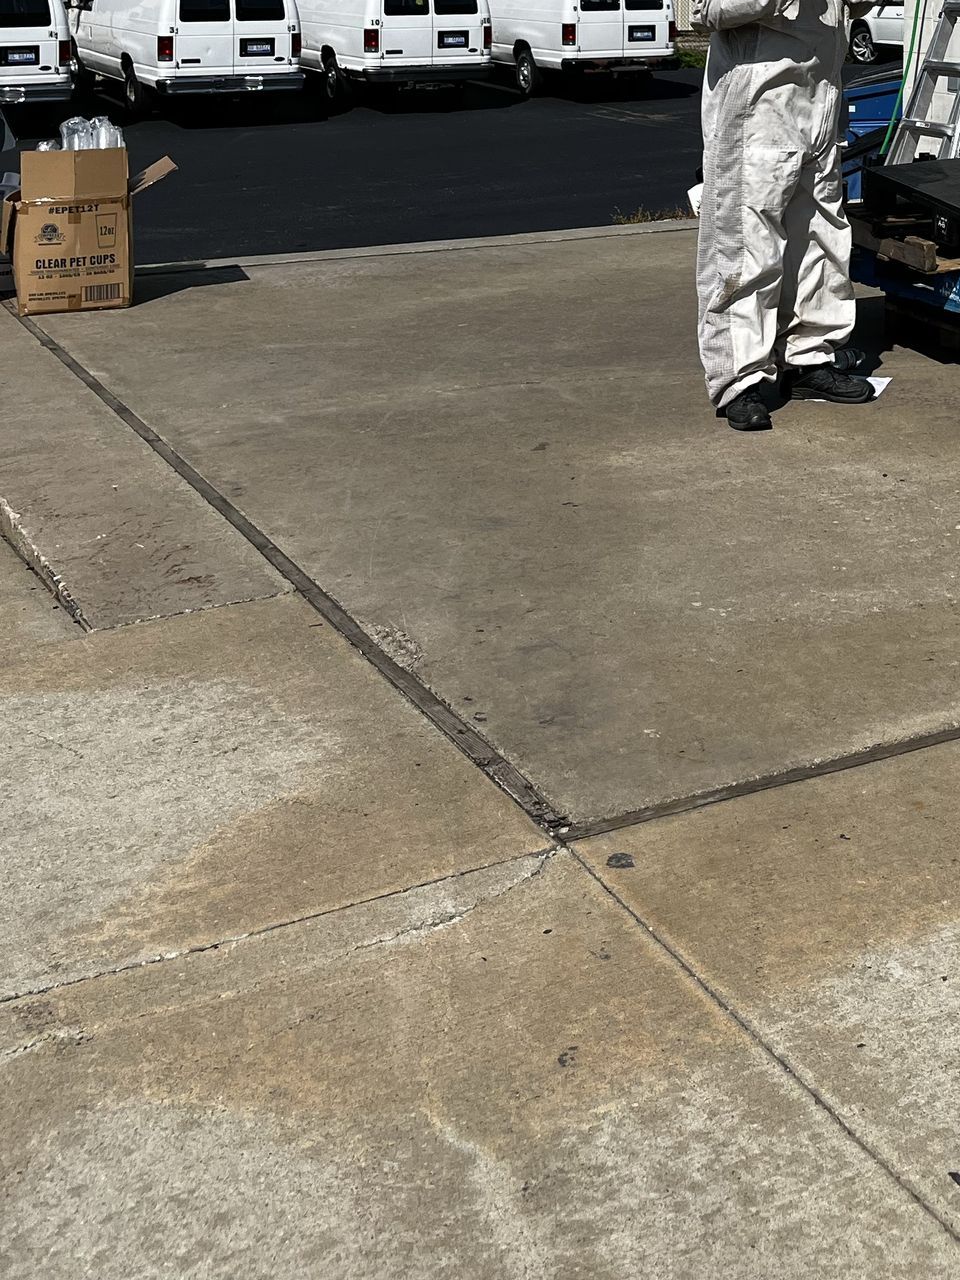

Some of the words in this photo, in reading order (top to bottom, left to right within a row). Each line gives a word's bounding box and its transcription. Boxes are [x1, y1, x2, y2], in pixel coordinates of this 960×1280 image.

[169, 26, 175, 34] 3
[48, 204, 100, 215] #EPET12T
[100, 225, 115, 237] 12oz
[35, 258, 67, 270] CLEAR
[69, 256, 87, 268] PET
[89, 253, 116, 266] CUPS
